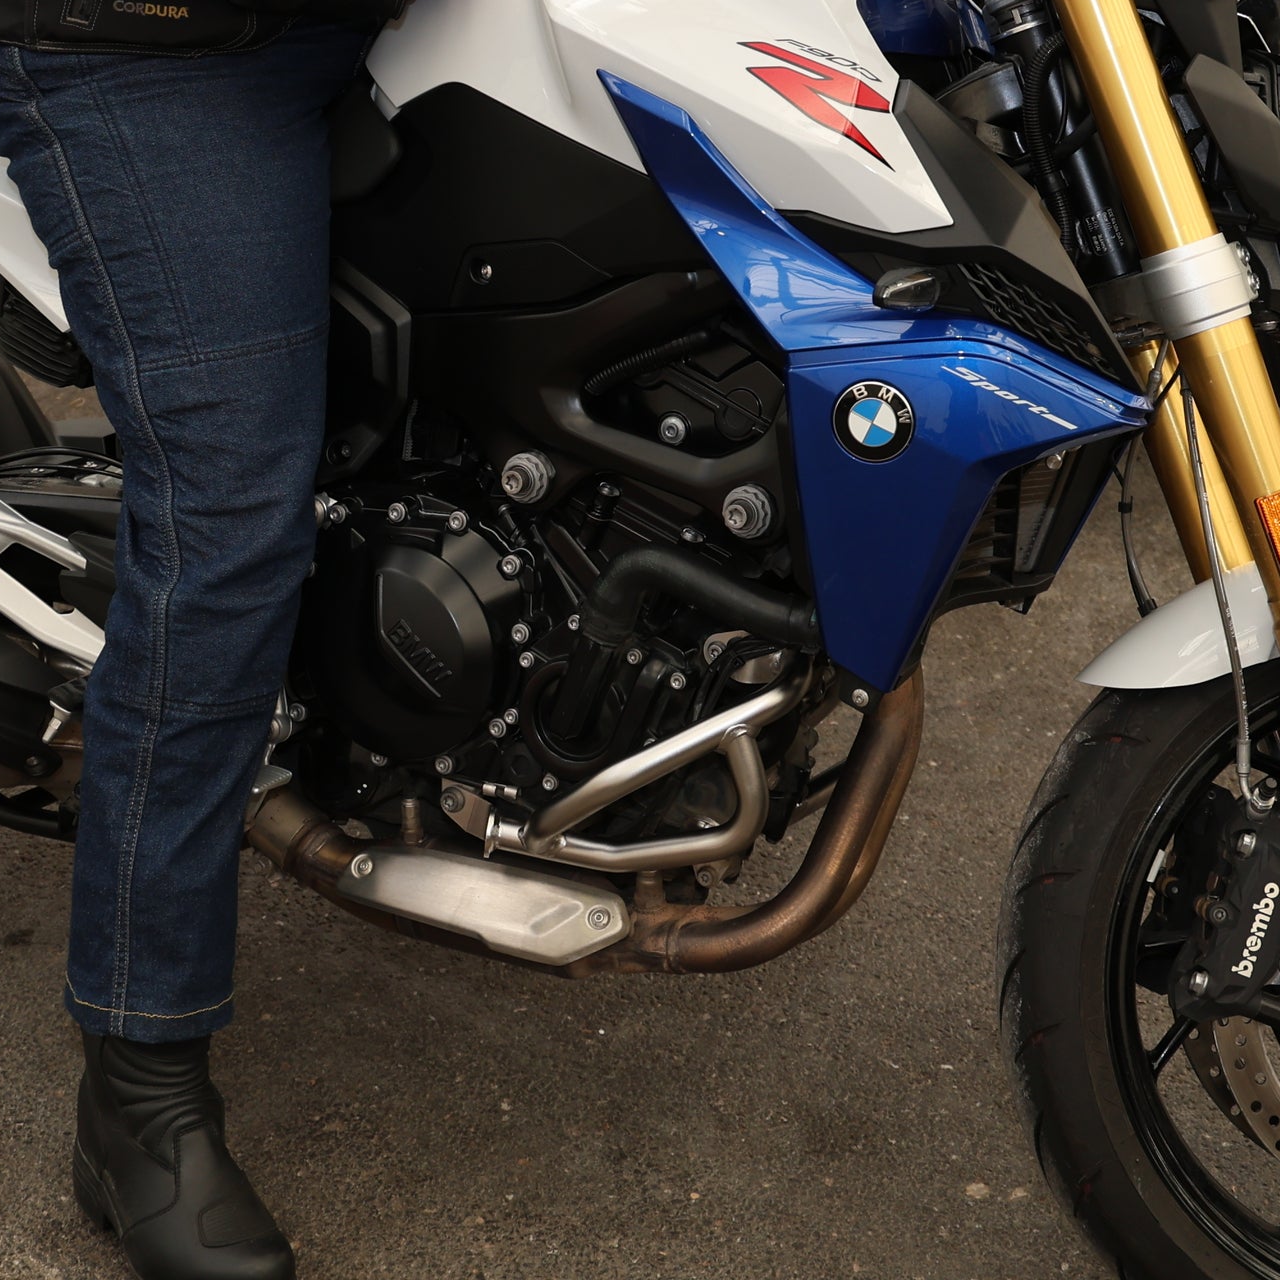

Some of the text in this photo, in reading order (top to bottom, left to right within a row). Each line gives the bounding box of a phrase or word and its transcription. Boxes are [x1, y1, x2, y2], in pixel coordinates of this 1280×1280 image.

[112, 0, 190, 19] CORDURA
[736, 41, 896, 172] R
[852, 385, 912, 424] BMW
[940, 365, 1078, 430] Sport
[387, 618, 453, 682] BMW
[1231, 882, 1280, 978] brembo
